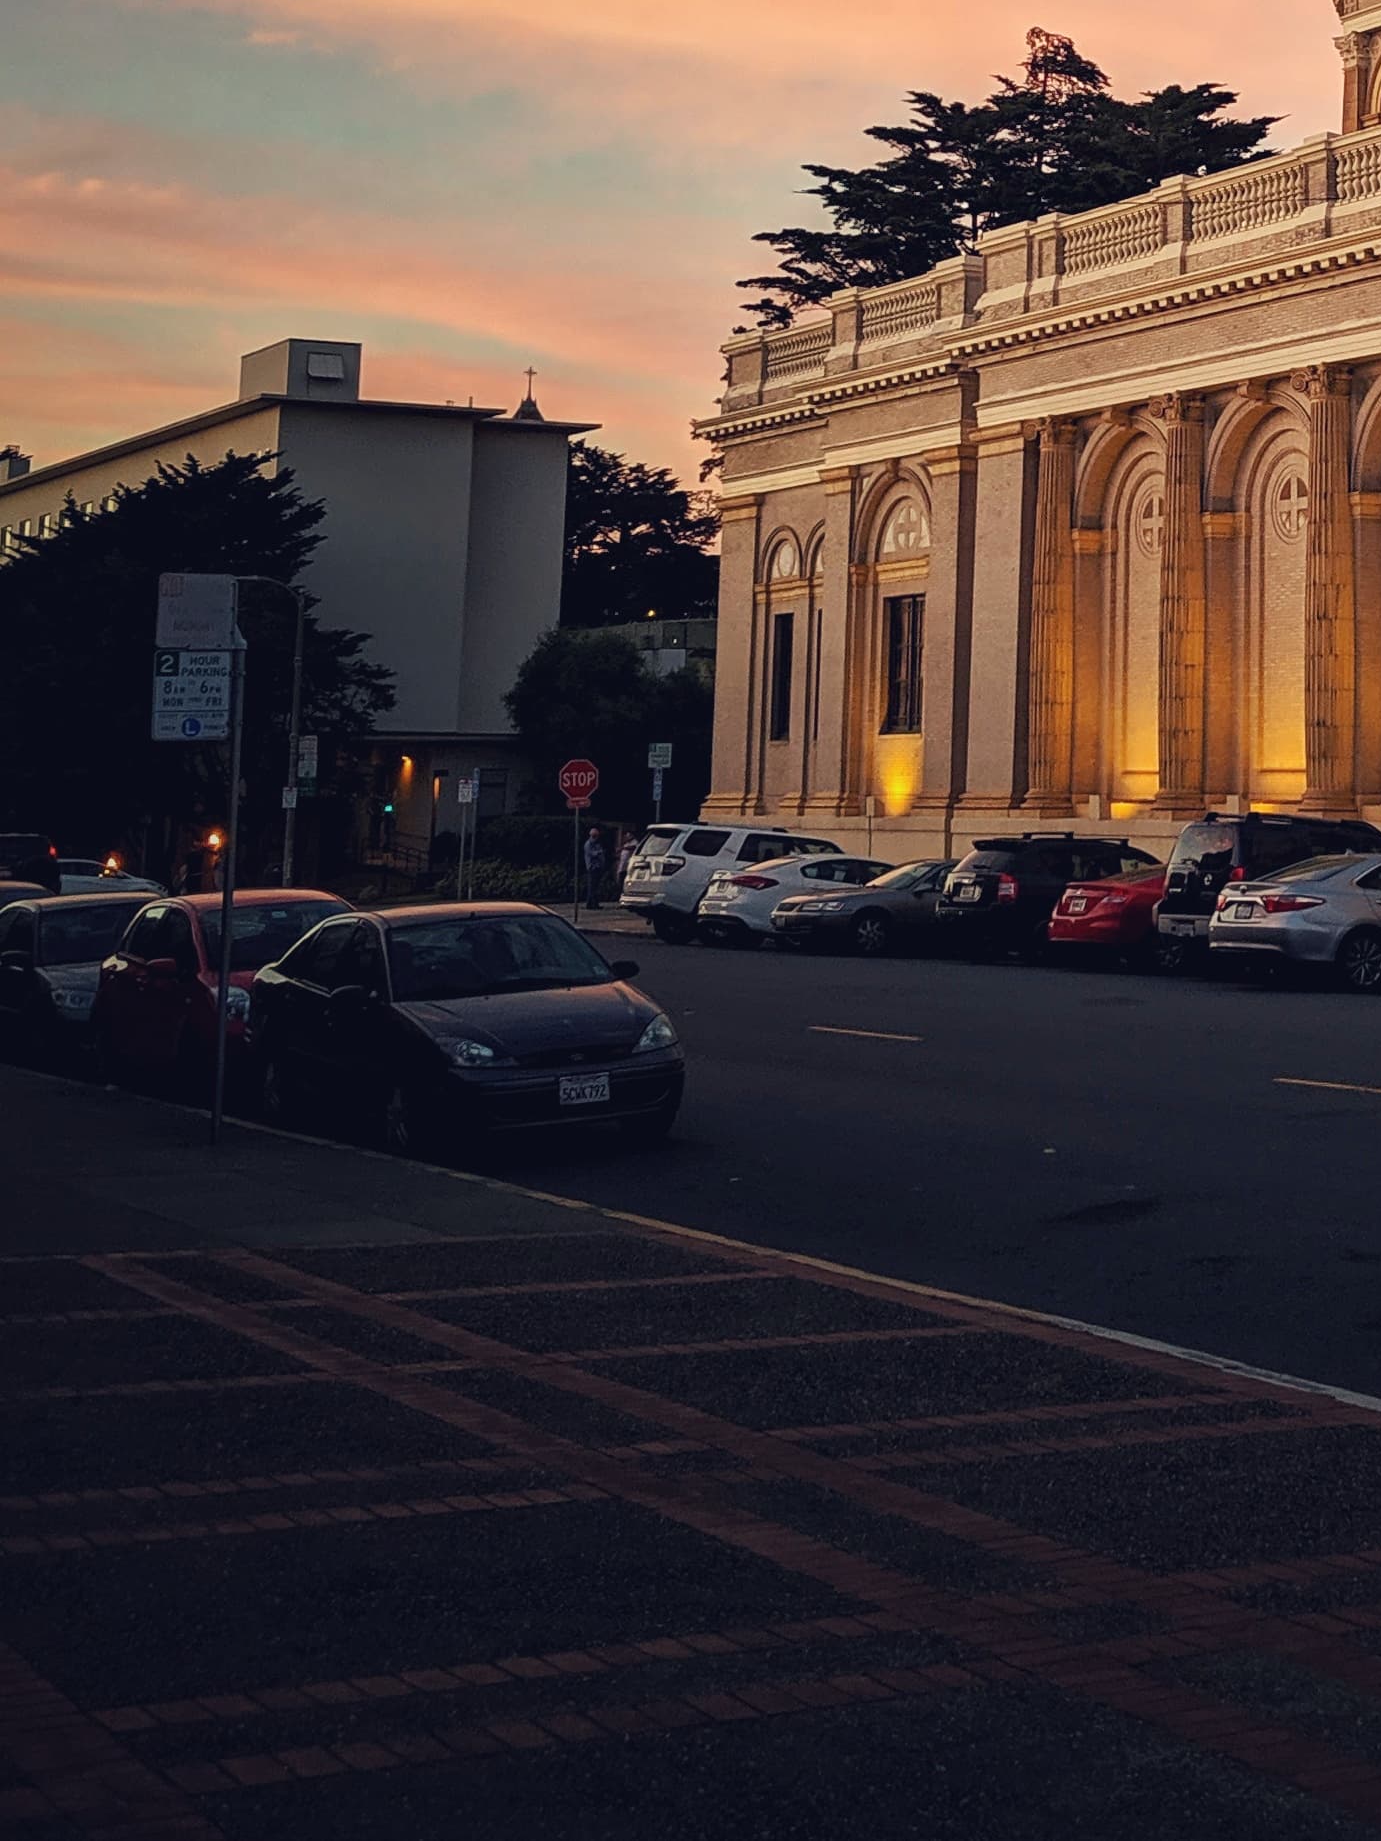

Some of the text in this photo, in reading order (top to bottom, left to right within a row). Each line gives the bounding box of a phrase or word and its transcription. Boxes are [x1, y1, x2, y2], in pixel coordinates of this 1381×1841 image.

[160, 655, 220, 673] 2 HOUR
[180, 666, 228, 677] PARKING
[163, 680, 186, 694] 8AM
[199, 680, 221, 694] 6PM
[162, 697, 184, 707] MON
[205, 697, 222, 706] FRI
[562, 771, 596, 788] STOP
